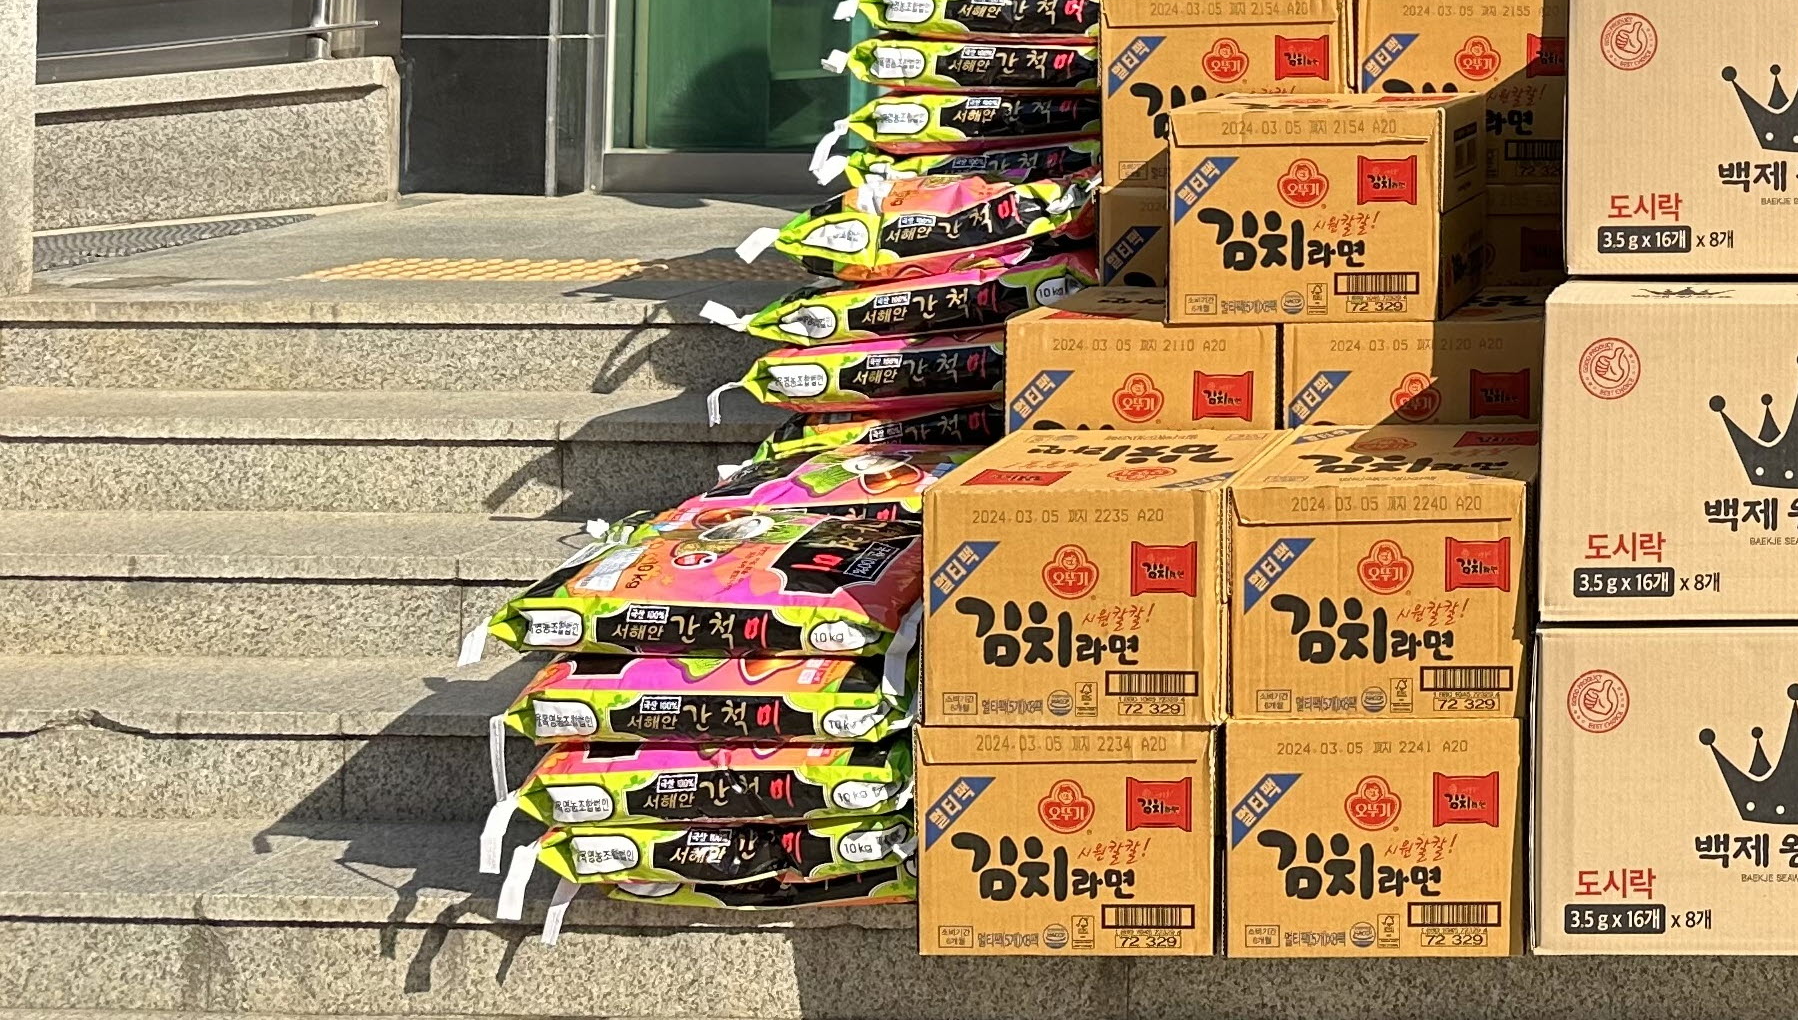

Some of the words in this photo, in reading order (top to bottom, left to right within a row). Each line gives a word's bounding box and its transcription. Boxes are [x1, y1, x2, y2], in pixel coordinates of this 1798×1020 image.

[1718, 160, 1788, 193] 백제
[1286, 179, 1321, 198] 오뚜기
[1607, 192, 1683, 222] 도시락
[1197, 208, 1366, 272] 김치라면
[1350, 302, 1370, 312] 72
[1374, 302, 1404, 312] 329
[1704, 497, 1778, 531] 백제
[1585, 532, 1666, 563] 도시락
[1749, 537, 1782, 546] BAEKJE
[1052, 572, 1089, 587] 오뚜기
[1367, 567, 1403, 582] 오뚜기
[1579, 574, 1604, 592] 3.5
[1635, 574, 1669, 593] 16개
[1694, 574, 1720, 593] 8개
[611, 624, 664, 642] 서해안
[955, 597, 1139, 667] 김치라면
[1271, 593, 1454, 664] 김치라면
[1124, 704, 1144, 714] 72
[1150, 704, 1181, 714] 329
[627, 715, 678, 730] 서해안
[1048, 805, 1085, 821] 오뚜기
[1354, 803, 1391, 818] 오뚜기
[1695, 834, 1769, 869] 백제
[951, 832, 1135, 901] 김치라면
[1257, 829, 1442, 900] 김치라면
[1575, 867, 1657, 900] 도시락
[1741, 874, 1773, 883] BAEKJE
[1425, 935, 1446, 945] 72
[1452, 935, 1484, 945] 329
